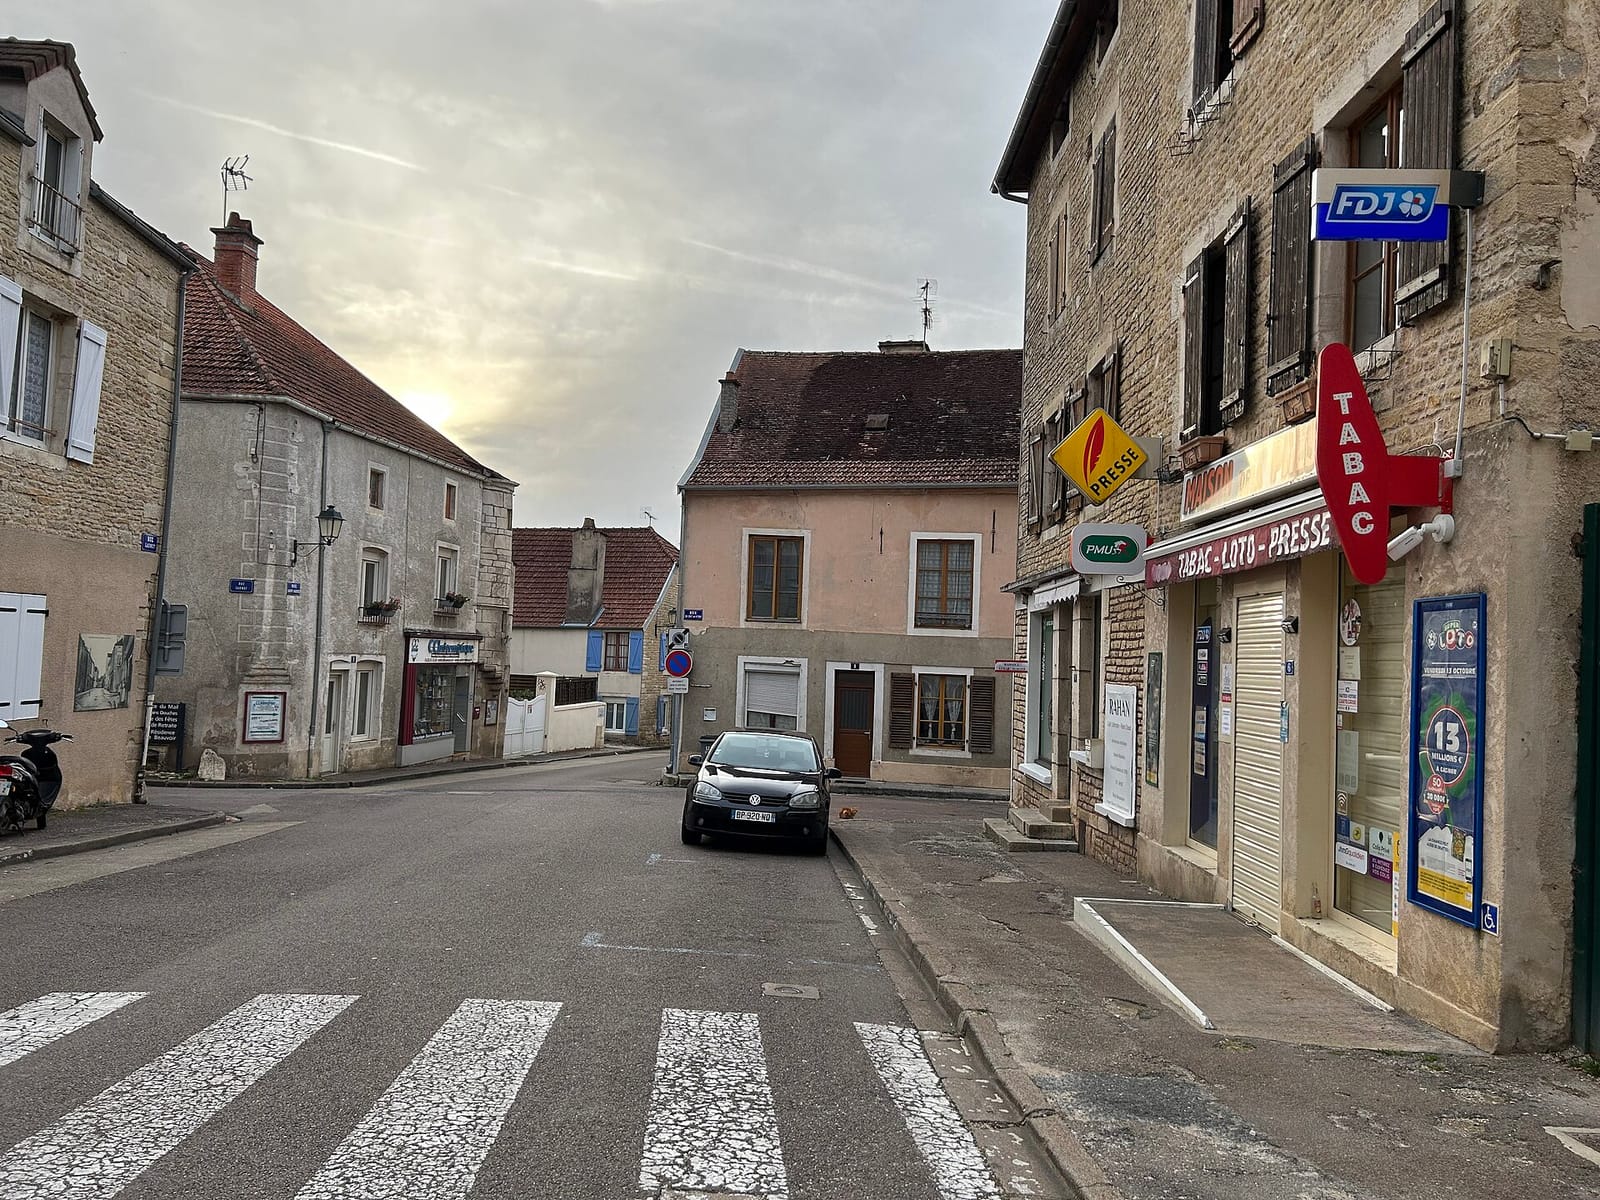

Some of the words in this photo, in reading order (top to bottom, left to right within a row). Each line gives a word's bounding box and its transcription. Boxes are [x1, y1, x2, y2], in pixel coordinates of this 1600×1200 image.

[1336, 191, 1396, 216] FDJ
[1089, 448, 1139, 496] PRESSE
[1332, 391, 1375, 535] TABAC
[1184, 459, 1235, 515] MAISON
[1086, 544, 1113, 555] PMU
[1178, 545, 1213, 578] TABAC
[1222, 533, 1255, 570] LOTO
[1269, 511, 1331, 559] PRESSE
[1439, 629, 1474, 648] LOTO
[1434, 721, 1460, 753] 13
[1431, 752, 1457, 763] MILLIONS
